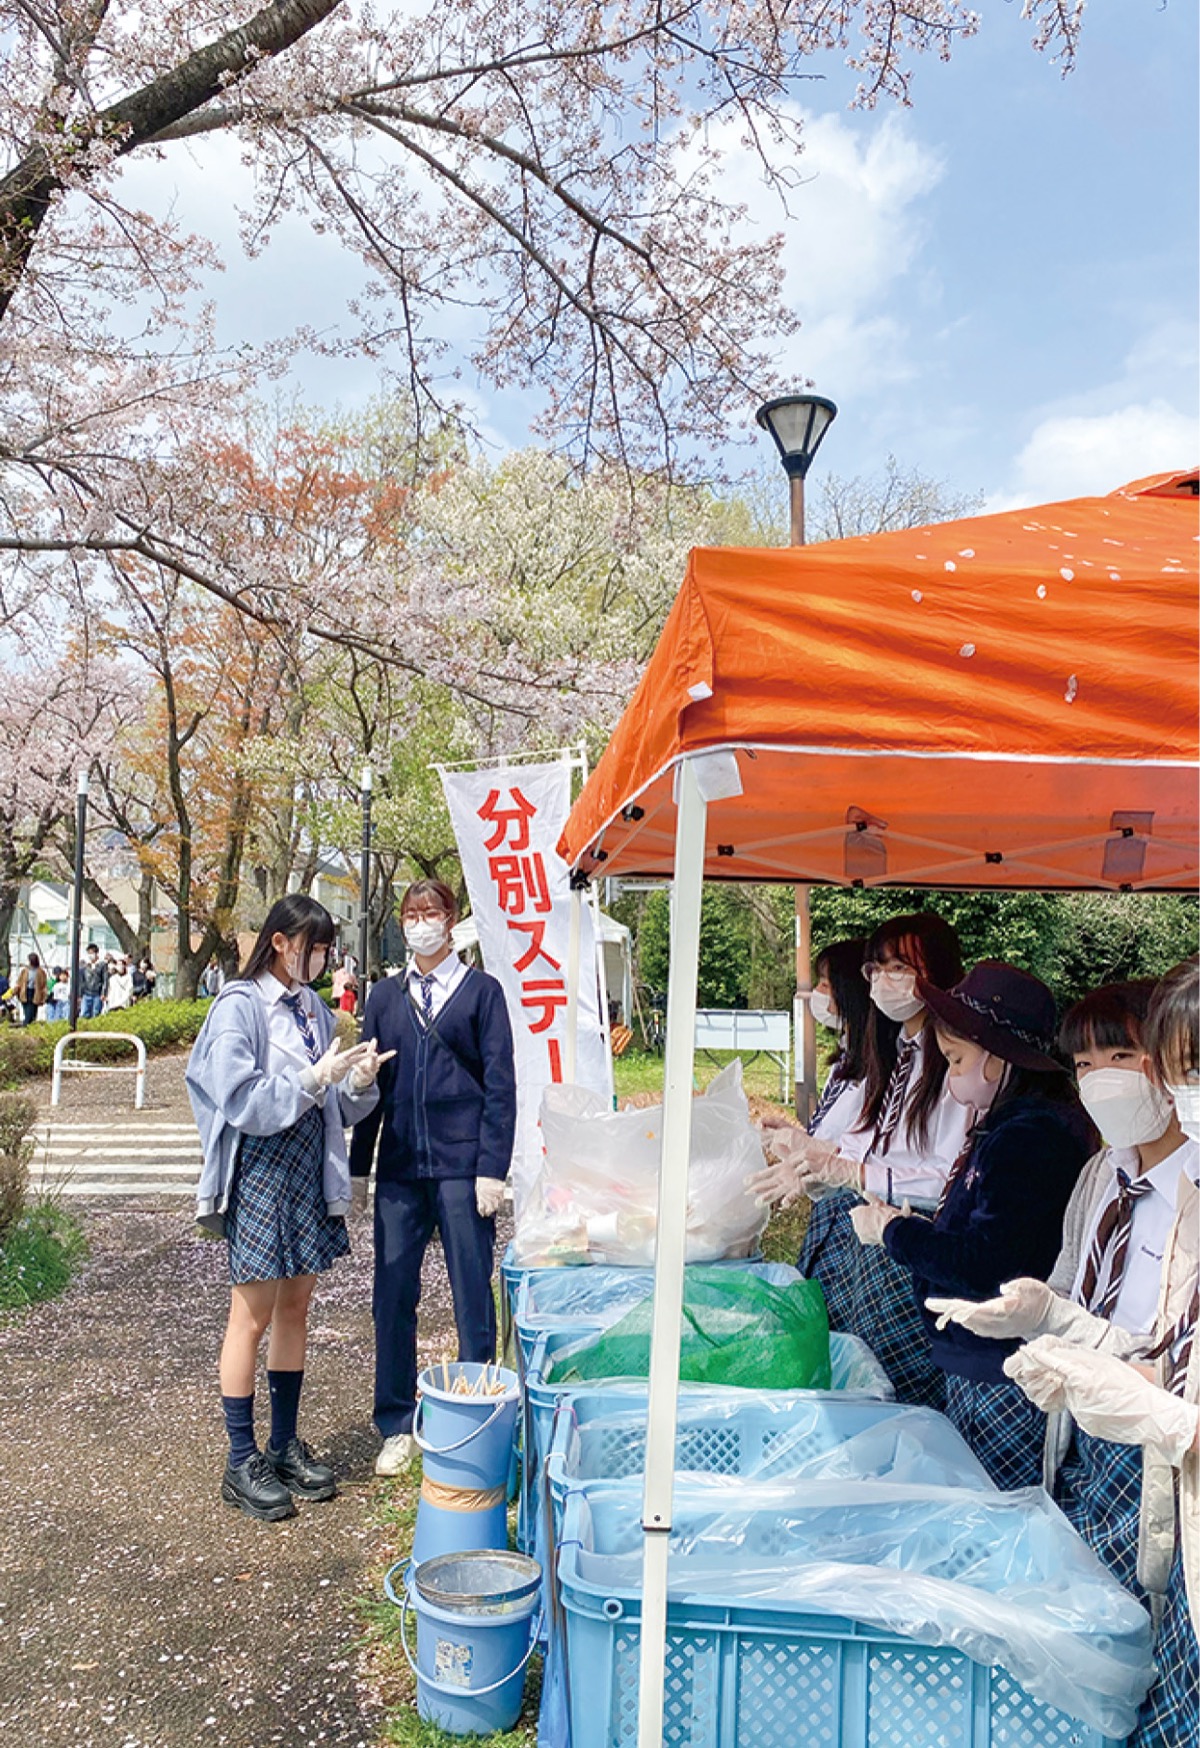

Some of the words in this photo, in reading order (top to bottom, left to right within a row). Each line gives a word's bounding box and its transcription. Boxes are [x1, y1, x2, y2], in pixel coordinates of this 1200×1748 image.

[476, 786, 568, 1155] 分別ステー
